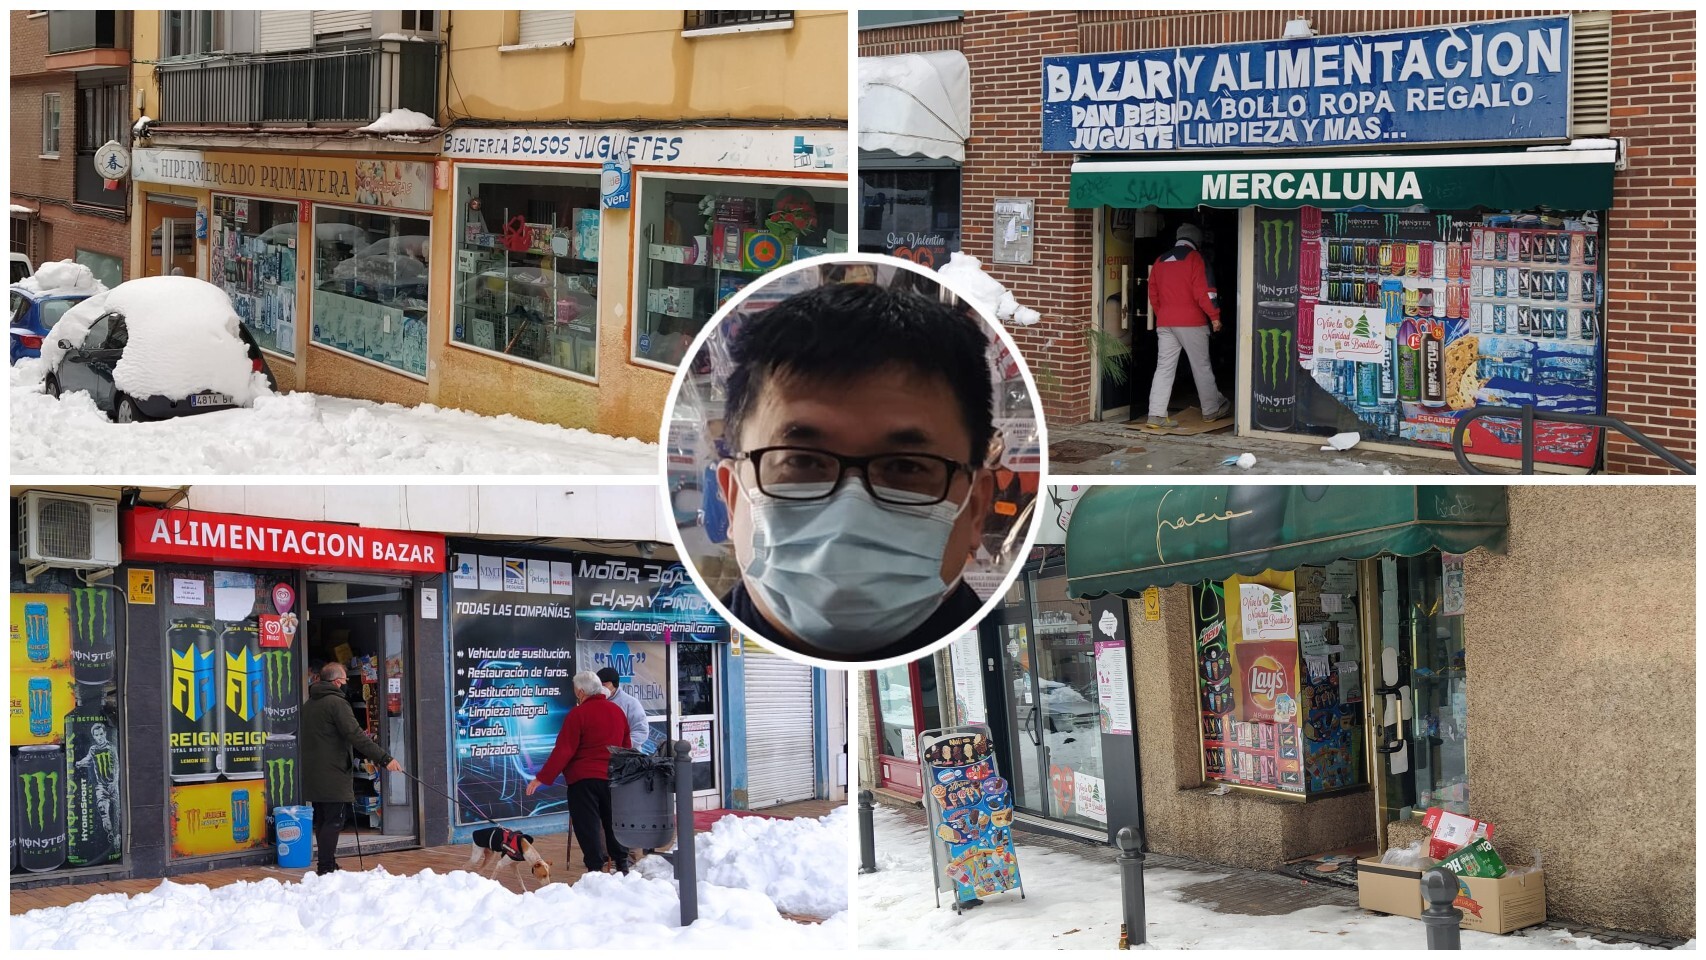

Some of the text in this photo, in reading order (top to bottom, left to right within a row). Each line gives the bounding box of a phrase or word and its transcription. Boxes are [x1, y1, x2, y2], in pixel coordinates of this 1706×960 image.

[1047, 27, 1564, 103] BAZAR Y ALIMENTACION
[1071, 104, 1117, 128] PAN
[1220, 94, 1306, 120] BOLLO
[1319, 89, 1396, 116] ROPA
[1406, 81, 1534, 112] REGALO
[1069, 115, 1408, 150] JUGUETE LIMPIEZA Y MAS...
[512, 135, 571, 156] BOLSOS
[574, 135, 683, 162] JUGUETES
[105, 153, 123, 170] 春
[160, 158, 350, 198] HIPERMERCADO PRIMAVERA
[1201, 171, 1424, 201] MERCALUNA
[1322, 328, 1351, 342] Navidad
[1427, 340, 1439, 396] IMPACTUM
[197, 395, 218, 405] 4814
[1254, 390, 1296, 407] MONSTER
[150, 518, 436, 564] ALIMENTACION BAZAR
[578, 560, 640, 584] MOTOR
[456, 602, 572, 619] TODAS LAS COMPAÑÍAS.
[594, 619, 716, 635] abadyalonso@hotmail.com
[70, 649, 115, 662] MONSTER
[508, 647, 520, 659] de
[521, 647, 572, 659] sustitución.
[468, 666, 569, 678] Restauración de faros.
[468, 684, 562, 698] Sustitución de lunas.
[621, 681, 664, 701] ADRILEÑA
[1251, 667, 1284, 701] Lay's
[264, 704, 298, 716] MONSTER
[469, 702, 549, 719] Limpieza integral.
[170, 731, 220, 747] REIGN
[224, 731, 271, 747] REIGN
[470, 724, 506, 737] Lavado.
[470, 742, 520, 759] Tapizados.
[19, 832, 66, 849] MONSTER
